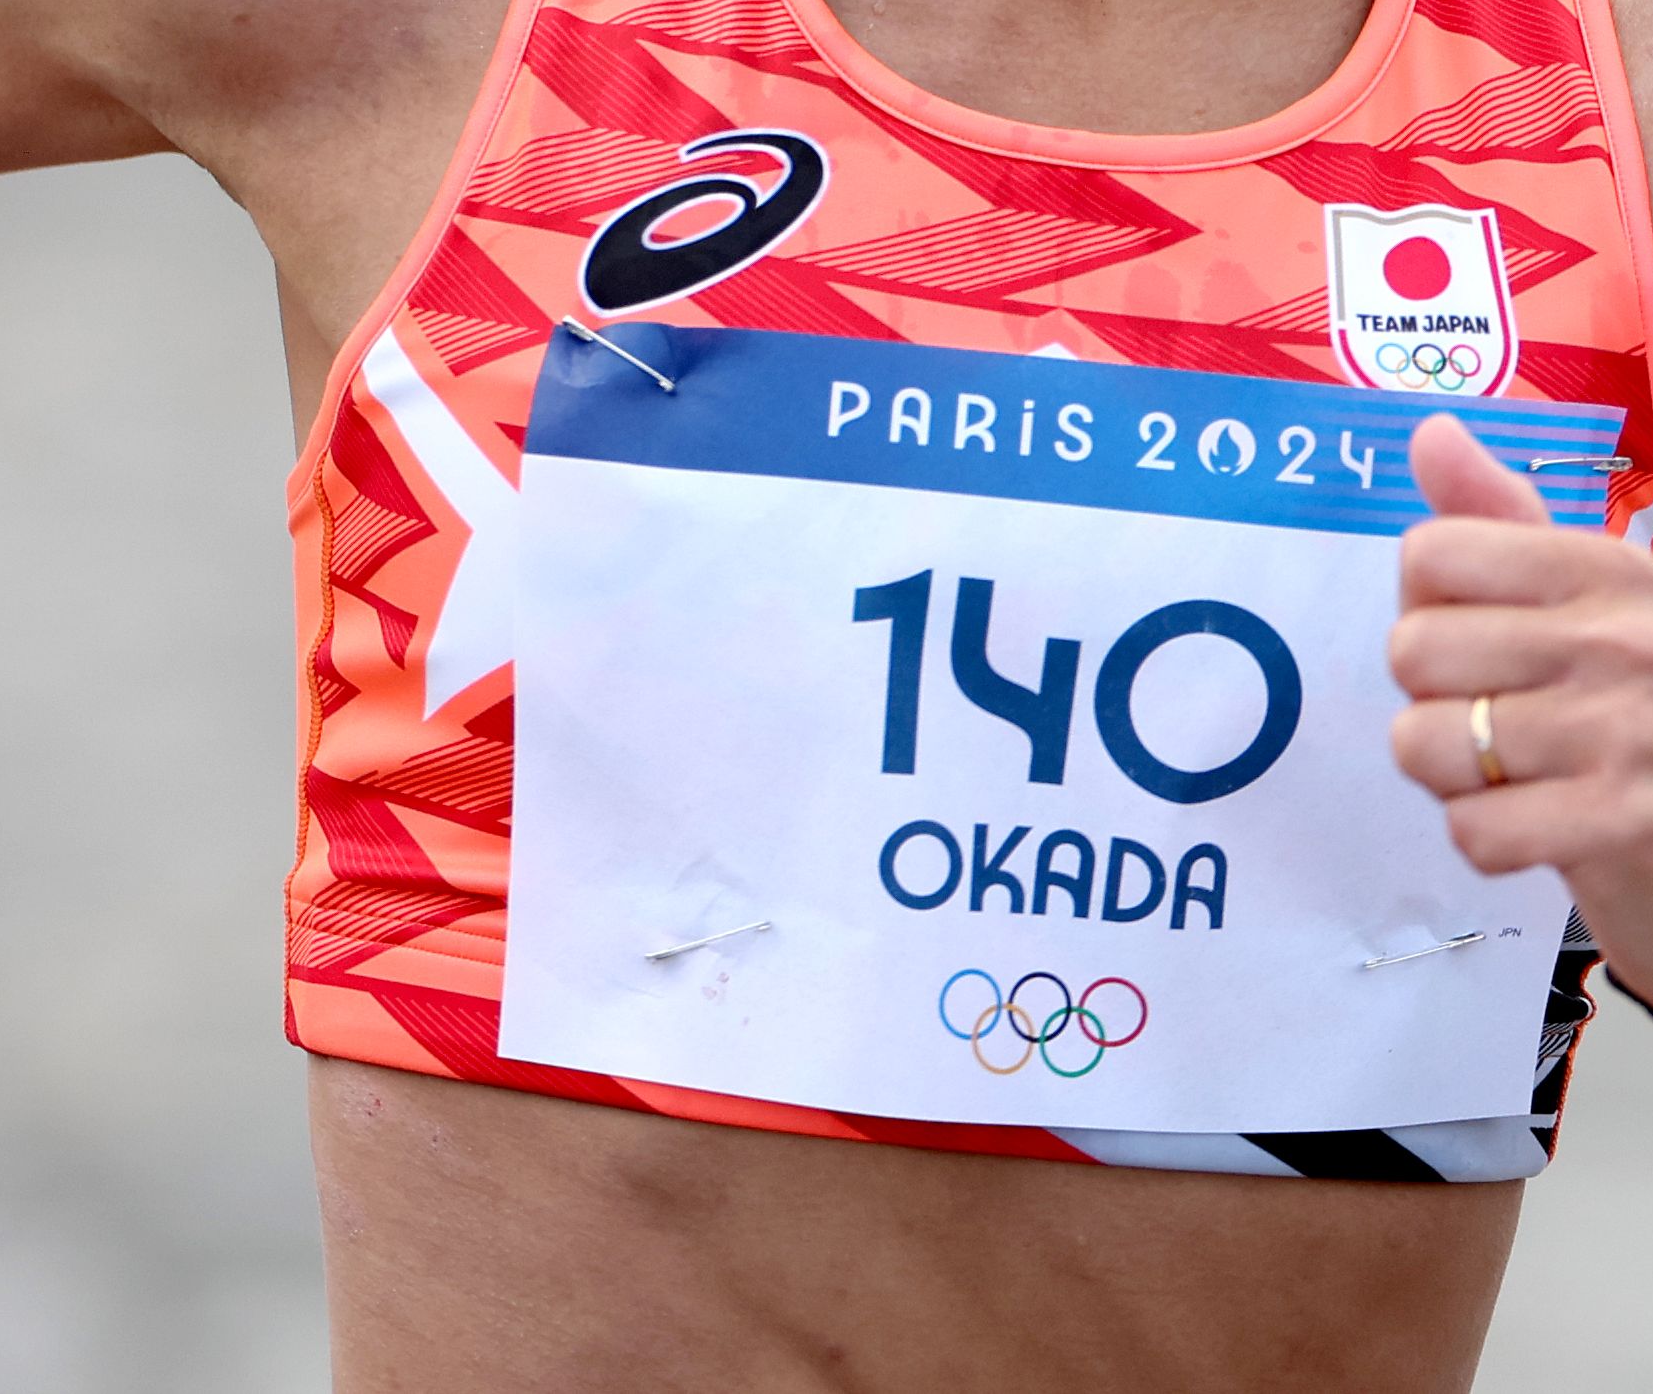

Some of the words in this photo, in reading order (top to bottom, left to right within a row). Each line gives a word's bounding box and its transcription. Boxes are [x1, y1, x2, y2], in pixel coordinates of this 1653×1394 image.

[1356, 314, 1418, 332] TEAM
[1422, 315, 1490, 334] JAPAN
[1136, 412, 1374, 489] 2024
[852, 569, 1302, 805] 140
[879, 819, 1228, 930] OKADA
[1498, 927, 1522, 937] JPN
